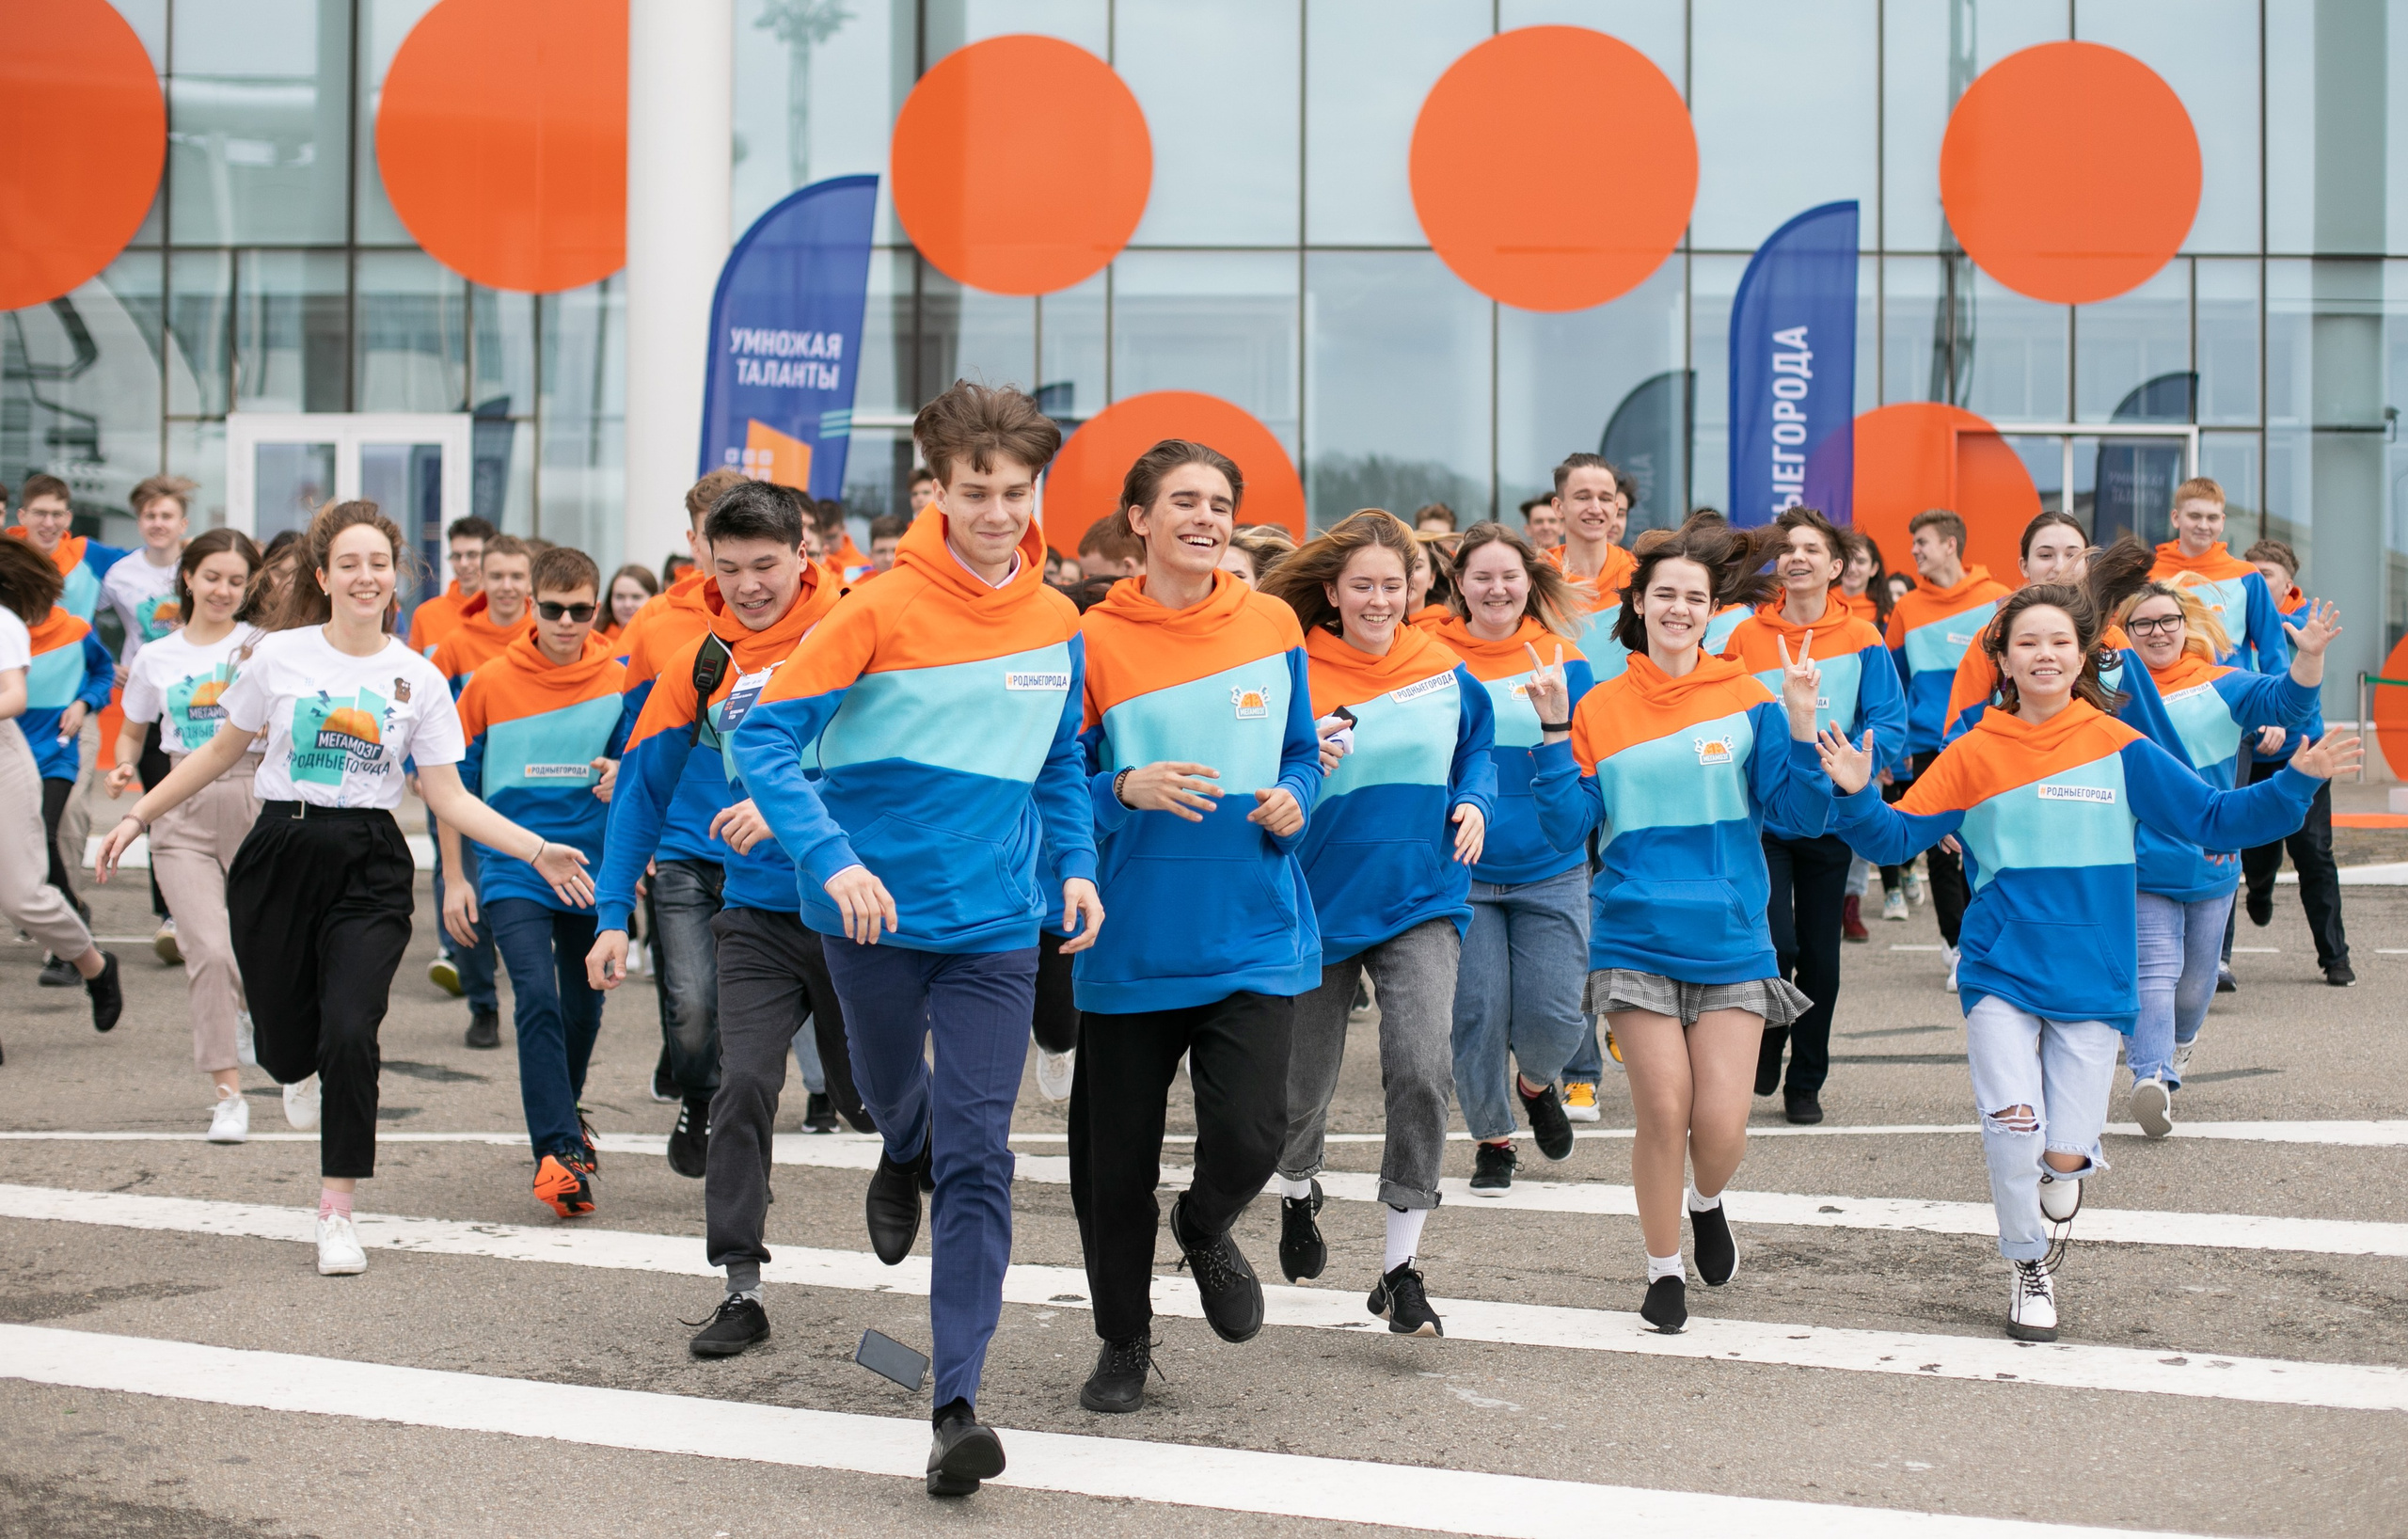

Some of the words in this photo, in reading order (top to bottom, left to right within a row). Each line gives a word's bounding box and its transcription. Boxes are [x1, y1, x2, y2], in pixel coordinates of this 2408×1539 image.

[730, 326, 844, 360] УМНОЖАЯ
[736, 357, 840, 391] ТАЛАНТЫ
[1771, 325, 1814, 523] ЫЕГОРОДА
[1007, 674, 1068, 688] #РОДНЫЕГОРОДА
[1392, 673, 1454, 700] #РОДНЫЕГОРОДА
[318, 733, 381, 758] МЕГАМОЗГ
[286, 749, 390, 776] #РОДНЫЕГООДА
[526, 766, 587, 776] #РОДНЫЕГОРОДА
[2040, 786, 2113, 801] #РОДНЫЕГОРОДА
